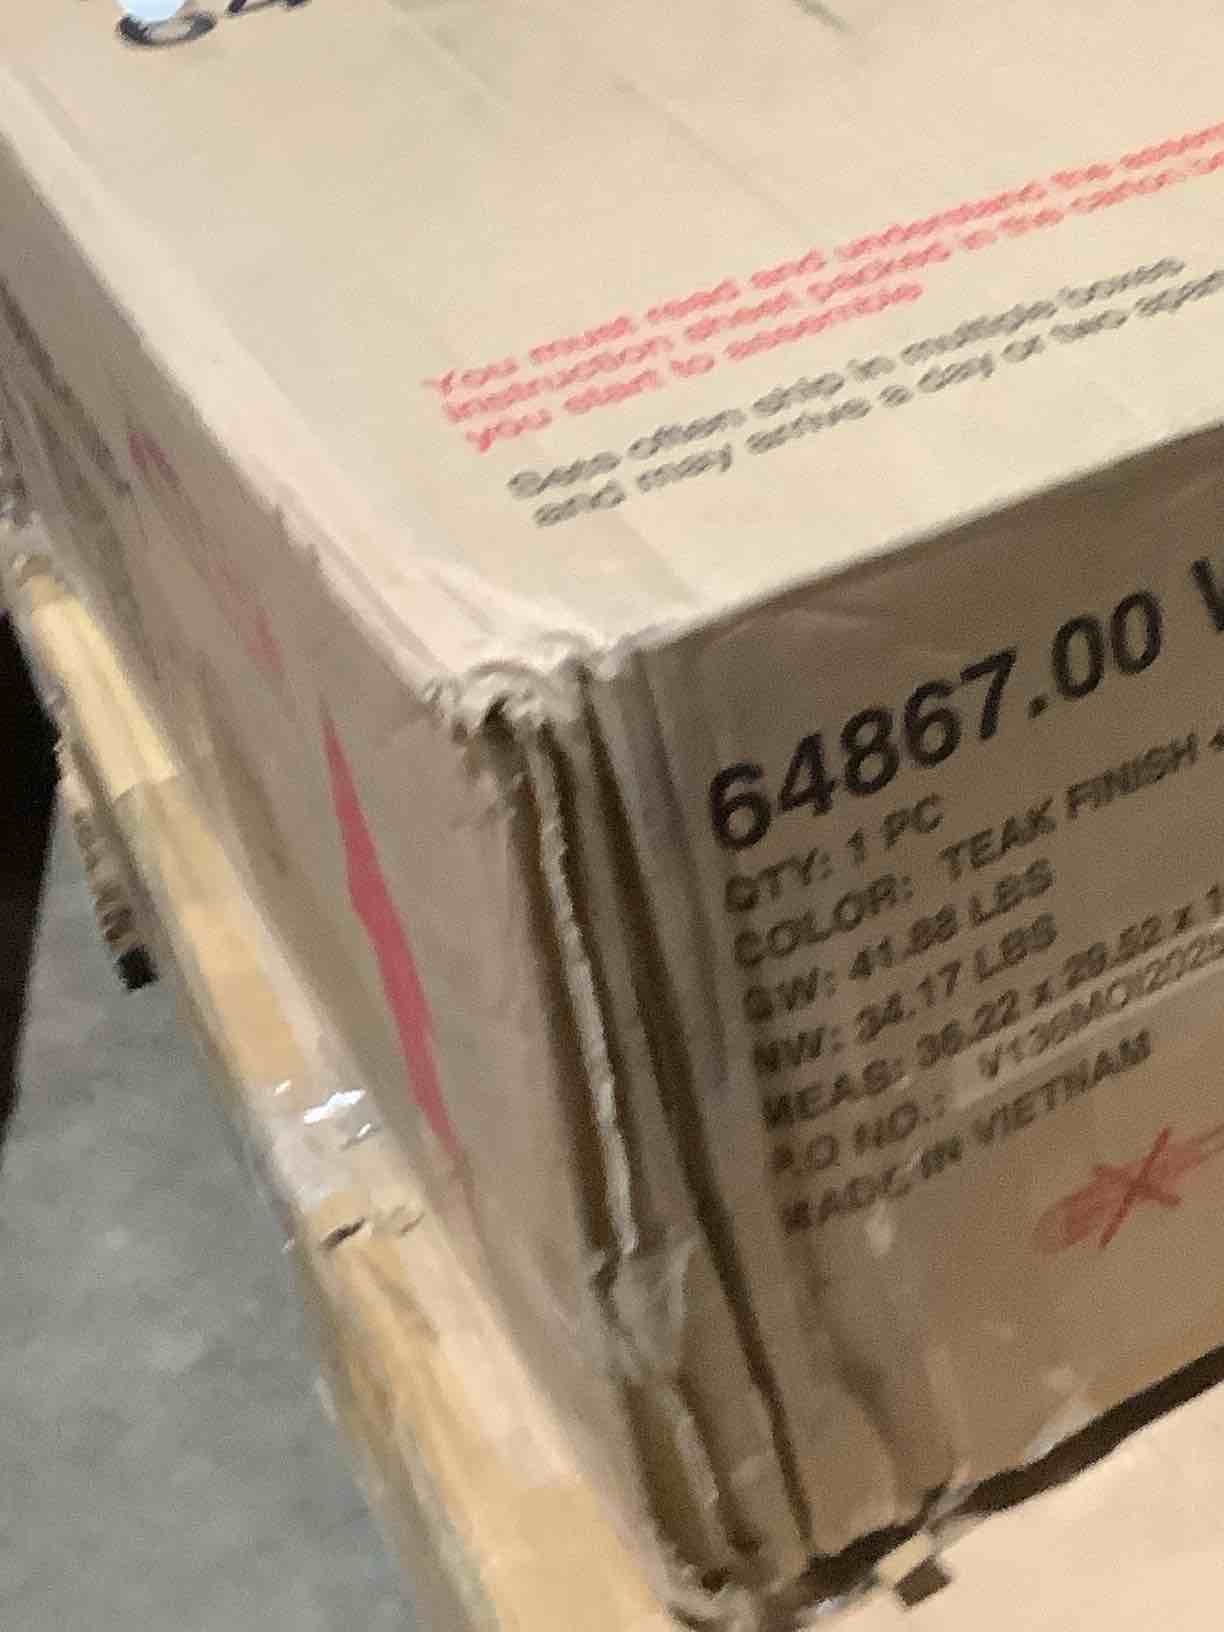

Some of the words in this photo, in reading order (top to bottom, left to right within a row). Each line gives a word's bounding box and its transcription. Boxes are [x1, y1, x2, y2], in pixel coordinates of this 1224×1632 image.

[421, 356, 520, 396] You
[528, 316, 636, 365] must
[647, 276, 741, 324] read
[750, 248, 828, 289] and
[1050, 162, 1114, 189] the
[443, 336, 675, 424] instruction
[466, 408, 553, 453] you
[563, 368, 666, 415] start
[669, 352, 716, 378] to
[533, 480, 626, 528] and
[635, 442, 733, 494] may
[745, 396, 872, 455] arrive
[877, 383, 914, 409] a
[916, 352, 996, 394] day
[1000, 334, 1047, 364] or
[1048, 308, 1129, 345] two
[627, 407, 747, 460] often
[751, 371, 846, 418] ship
[846, 355, 897, 382] in
[900, 299, 1058, 367] multiple
[707, 589, 1165, 853] 64867.00
[725, 847, 834, 913] QTY:
[847, 827, 867, 865] 1
[880, 792, 945, 850] PC
[734, 873, 914, 968] COLOR:
[938, 798, 1057, 881] TEAK
[1065, 732, 1200, 821] FINISH
[968, 858, 1056, 928] LBS
[752, 1024, 845, 1074] NW:
[855, 959, 962, 1045] 34.17
[973, 911, 1058, 984] LBS
[761, 1057, 906, 1131] MEAS:
[1033, 977, 1054, 1011] x
[1172, 902, 1195, 935] x
[970, 1029, 1152, 1148] VIETNAM
